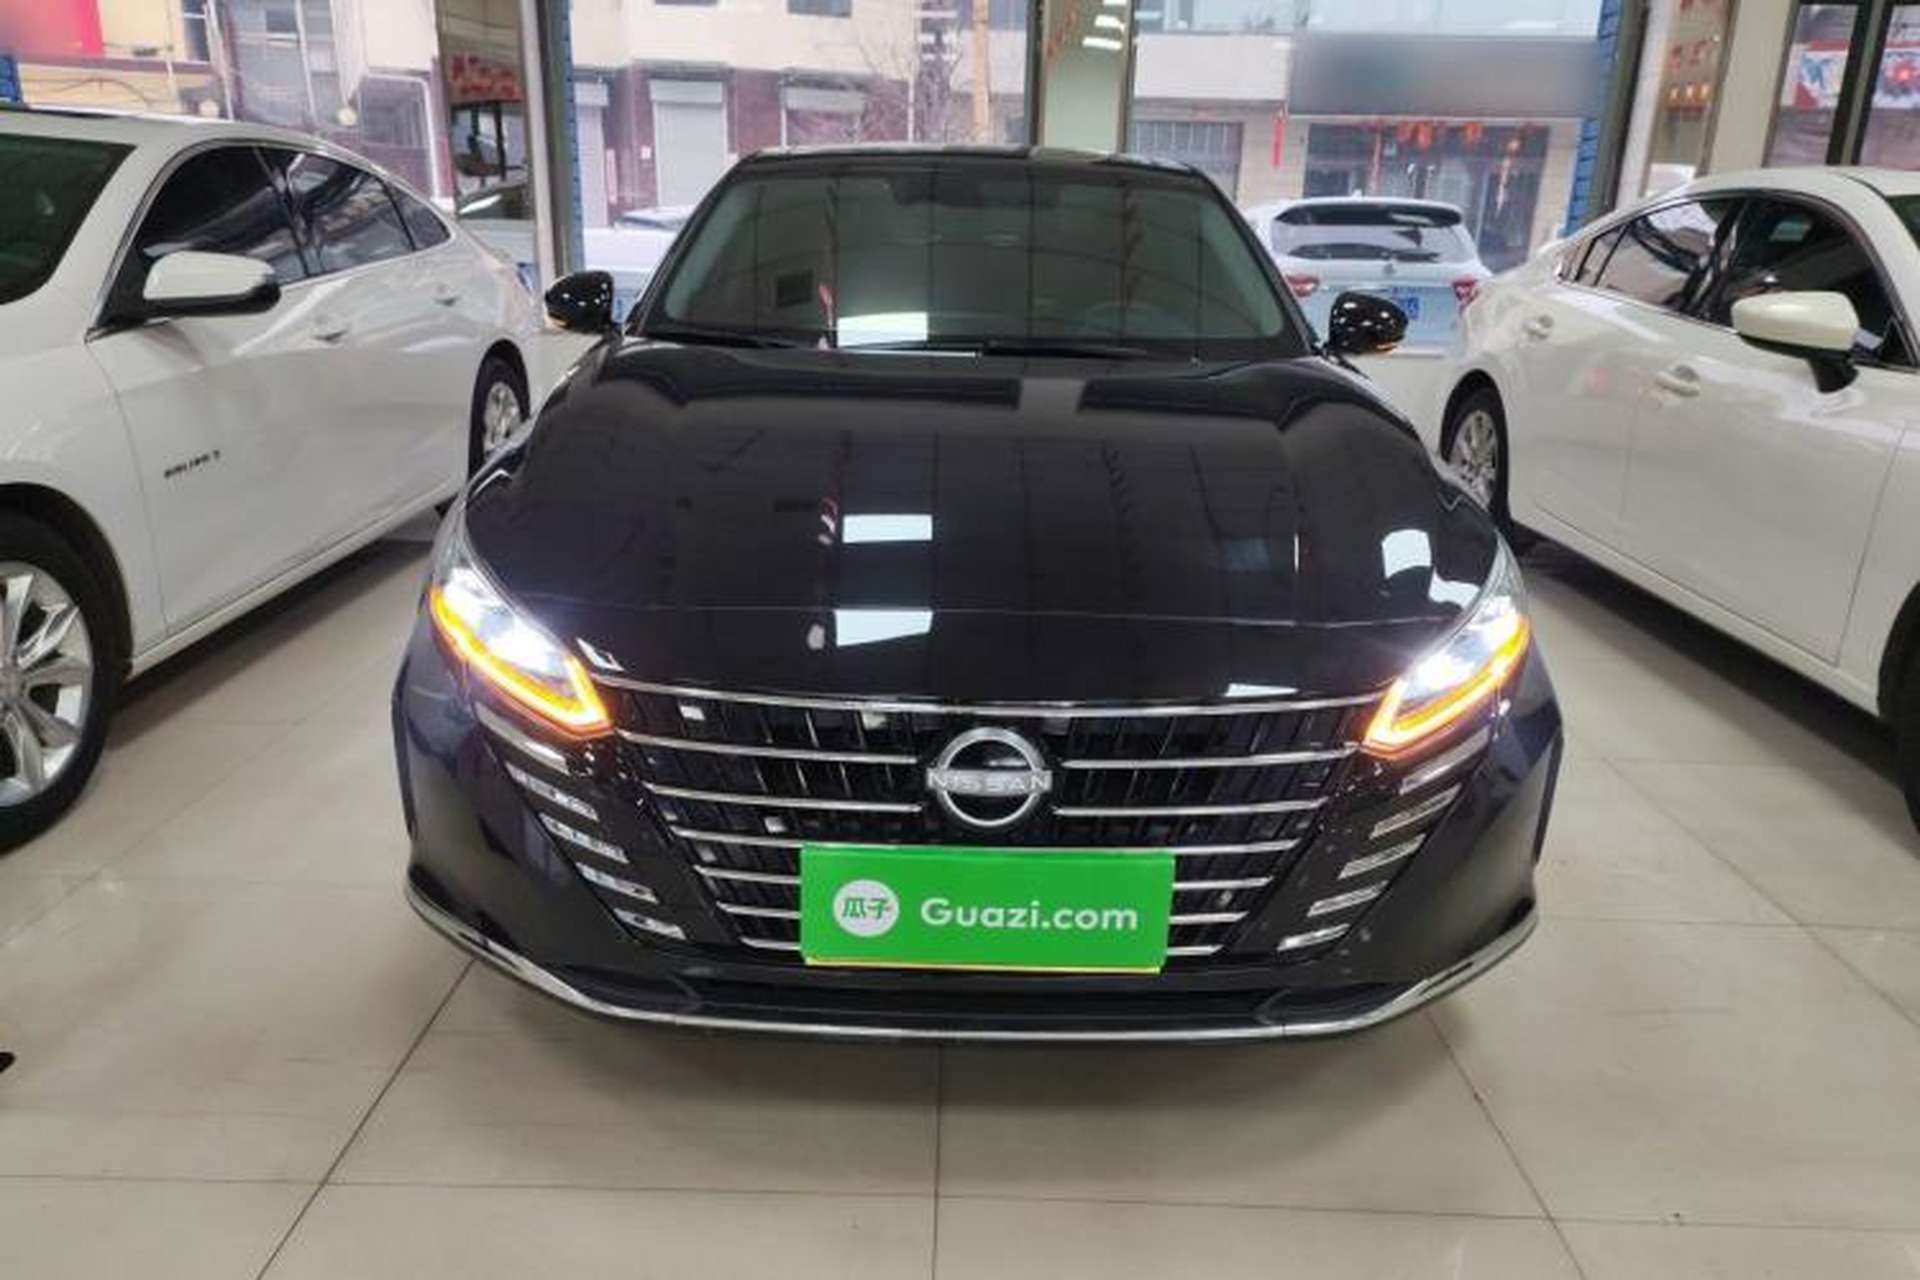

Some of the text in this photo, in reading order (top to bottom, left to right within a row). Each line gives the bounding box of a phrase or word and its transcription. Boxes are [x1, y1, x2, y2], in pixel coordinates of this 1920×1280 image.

[928, 770, 1052, 793] NISSAN
[842, 897, 890, 920] 瓜子
[920, 897, 1138, 931] Guazi.com
